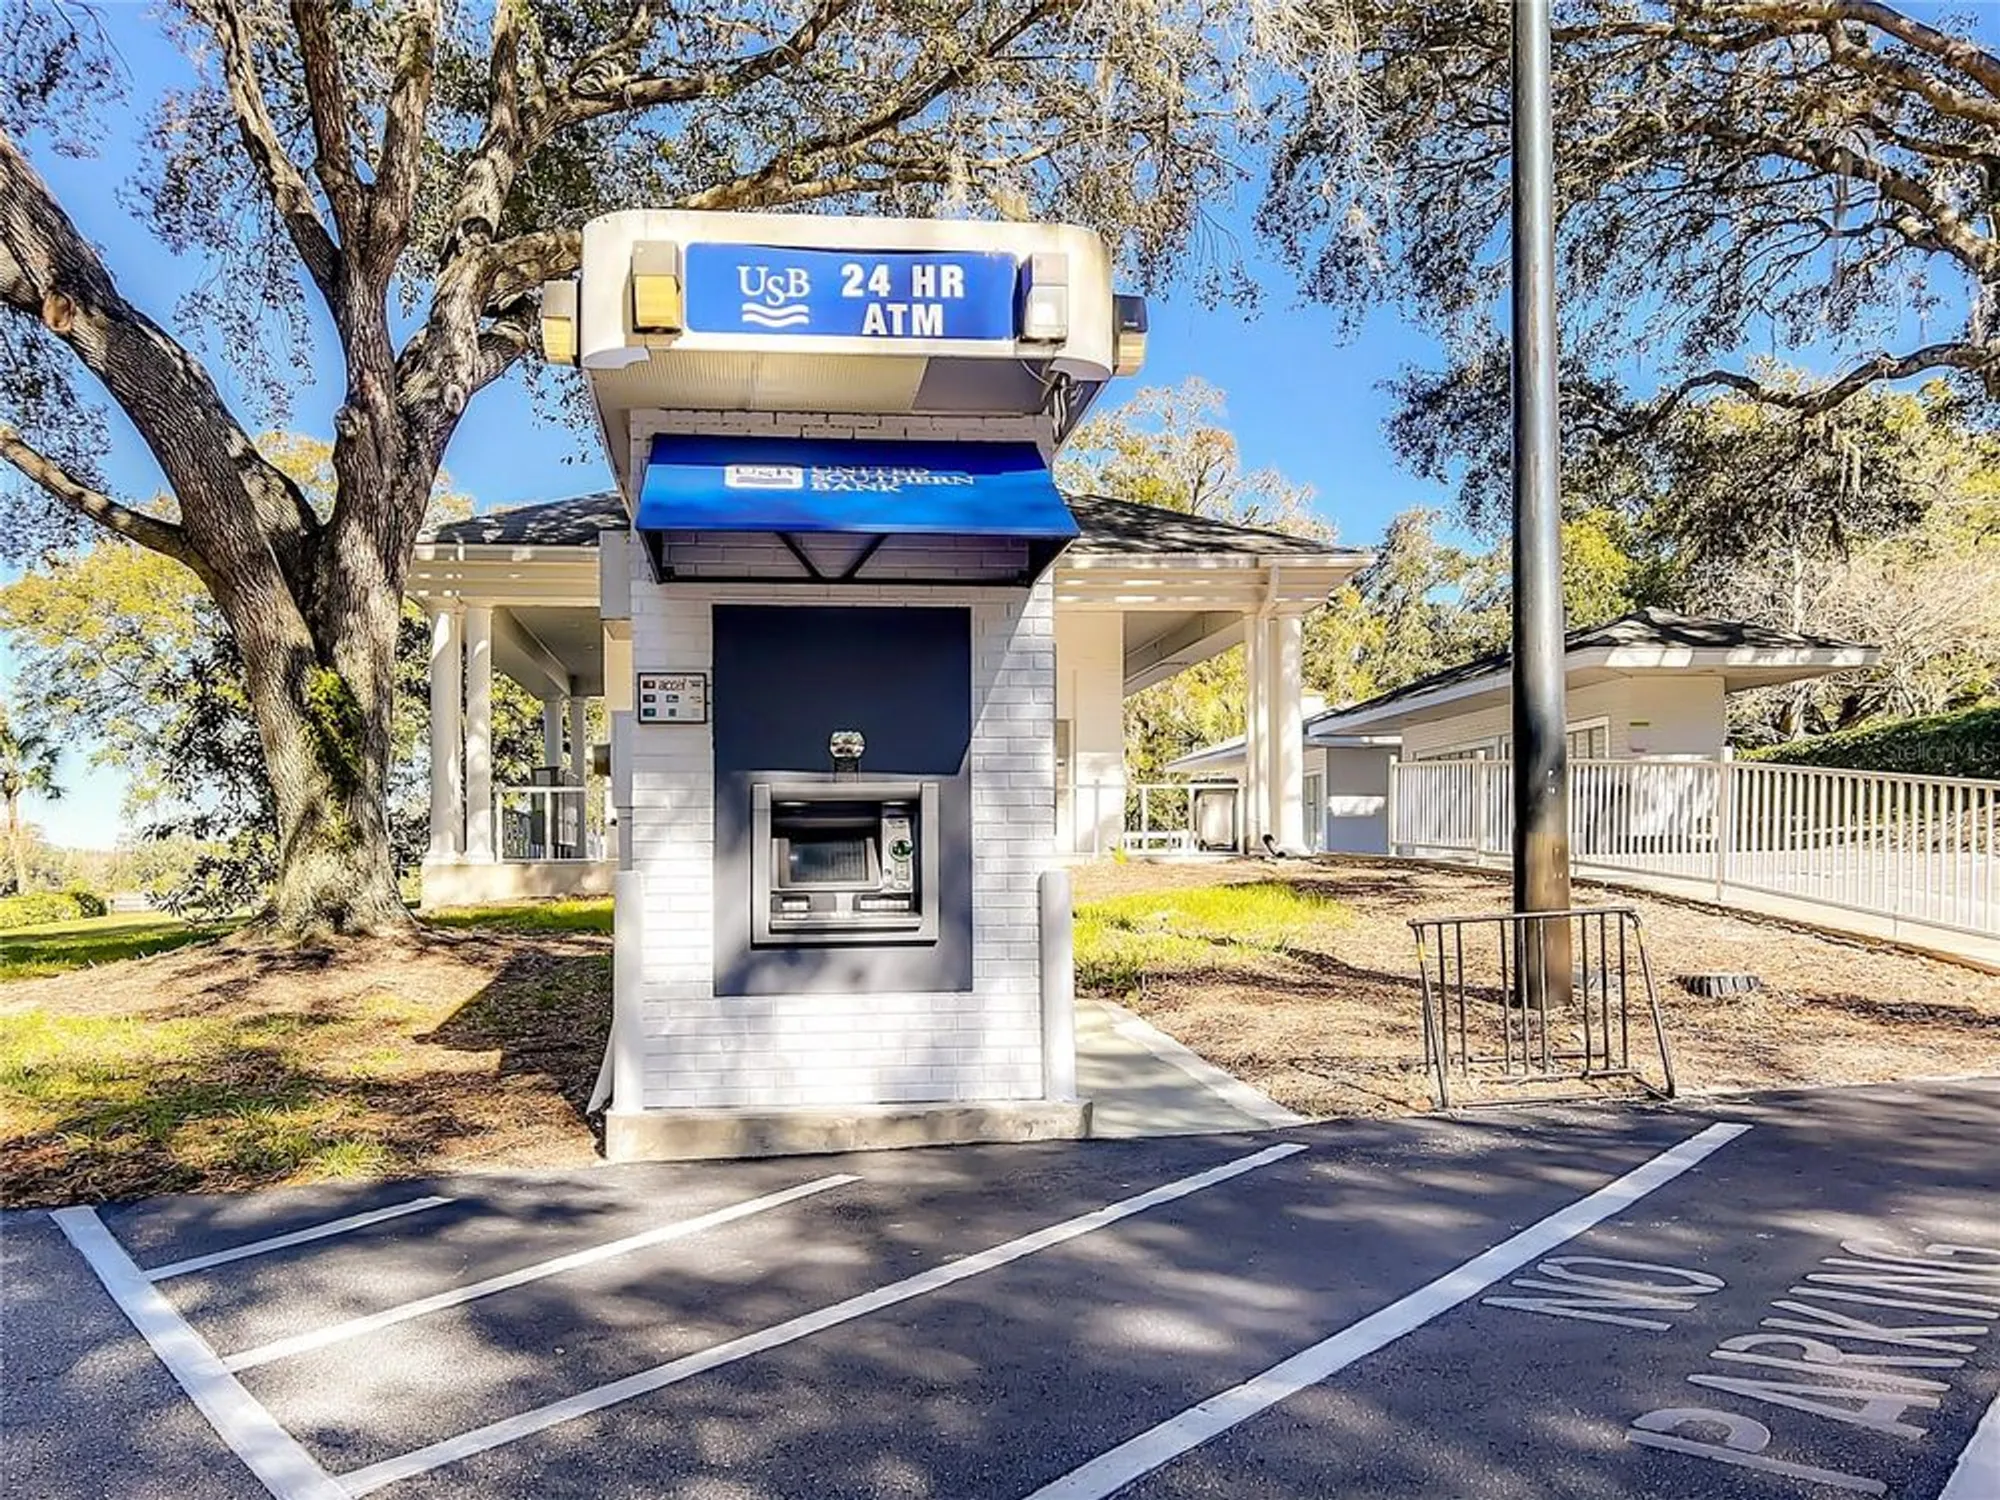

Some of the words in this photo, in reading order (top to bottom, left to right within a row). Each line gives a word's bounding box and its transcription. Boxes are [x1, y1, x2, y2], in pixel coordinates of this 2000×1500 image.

[841, 263, 891, 297] 24
[912, 264, 964, 298] HR
[862, 303, 943, 336] ATM
[1482, 1256, 1726, 1331] NO
[1626, 1238, 2000, 1496] PARKING
